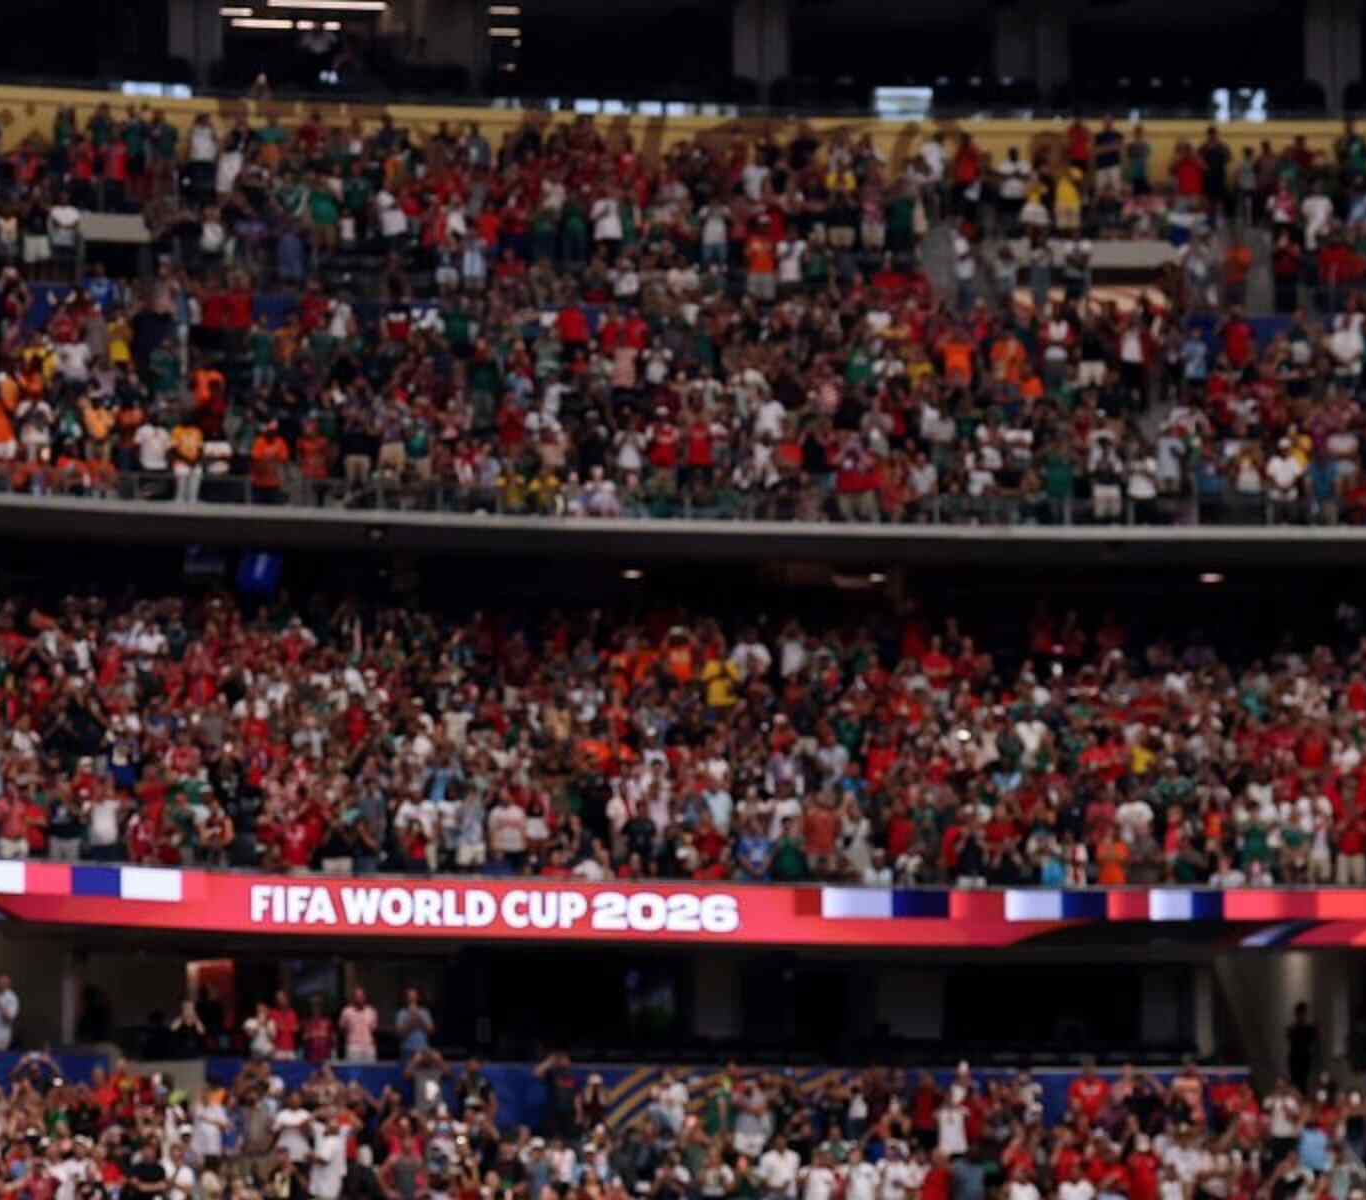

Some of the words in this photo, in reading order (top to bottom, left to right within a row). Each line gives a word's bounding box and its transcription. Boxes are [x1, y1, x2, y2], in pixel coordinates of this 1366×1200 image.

[250, 885, 336, 924] FIFA
[340, 888, 496, 927] WORLD
[501, 890, 587, 928] CUP
[592, 892, 739, 931] 2026
